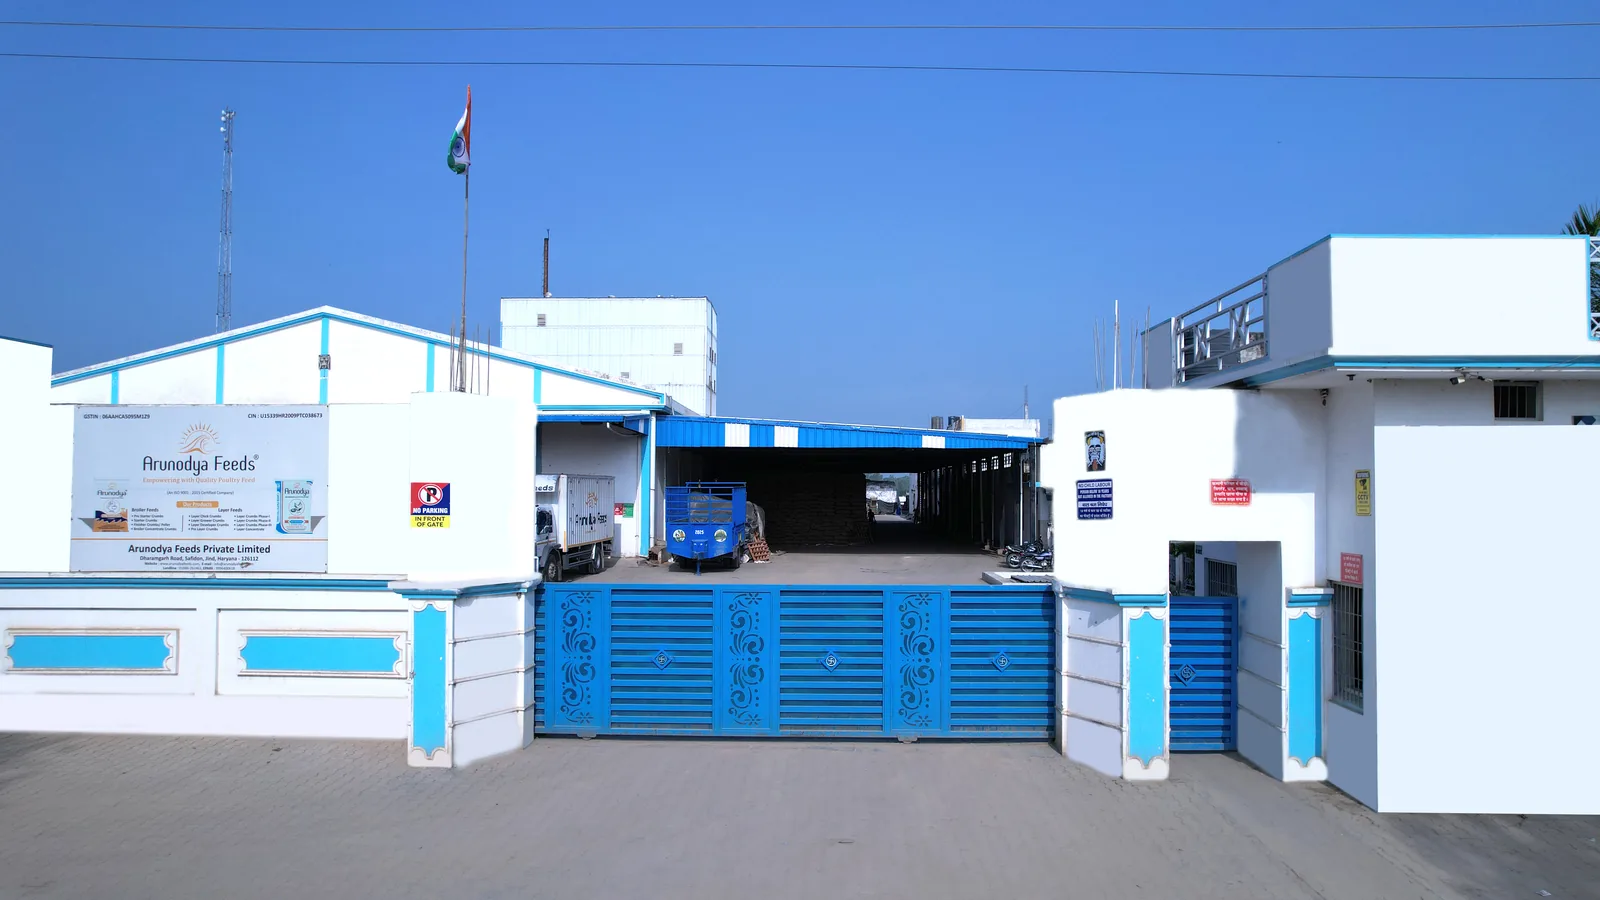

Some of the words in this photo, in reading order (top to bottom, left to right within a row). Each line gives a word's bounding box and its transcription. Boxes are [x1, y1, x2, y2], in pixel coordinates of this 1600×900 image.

[143, 455, 208, 476] Arunodya
[284, 488, 310, 497] Arunodya
[128, 545, 172, 554] Arunodya
[175, 545, 200, 553] Feeds
[204, 545, 234, 553] Private
[237, 545, 270, 553] Limited
